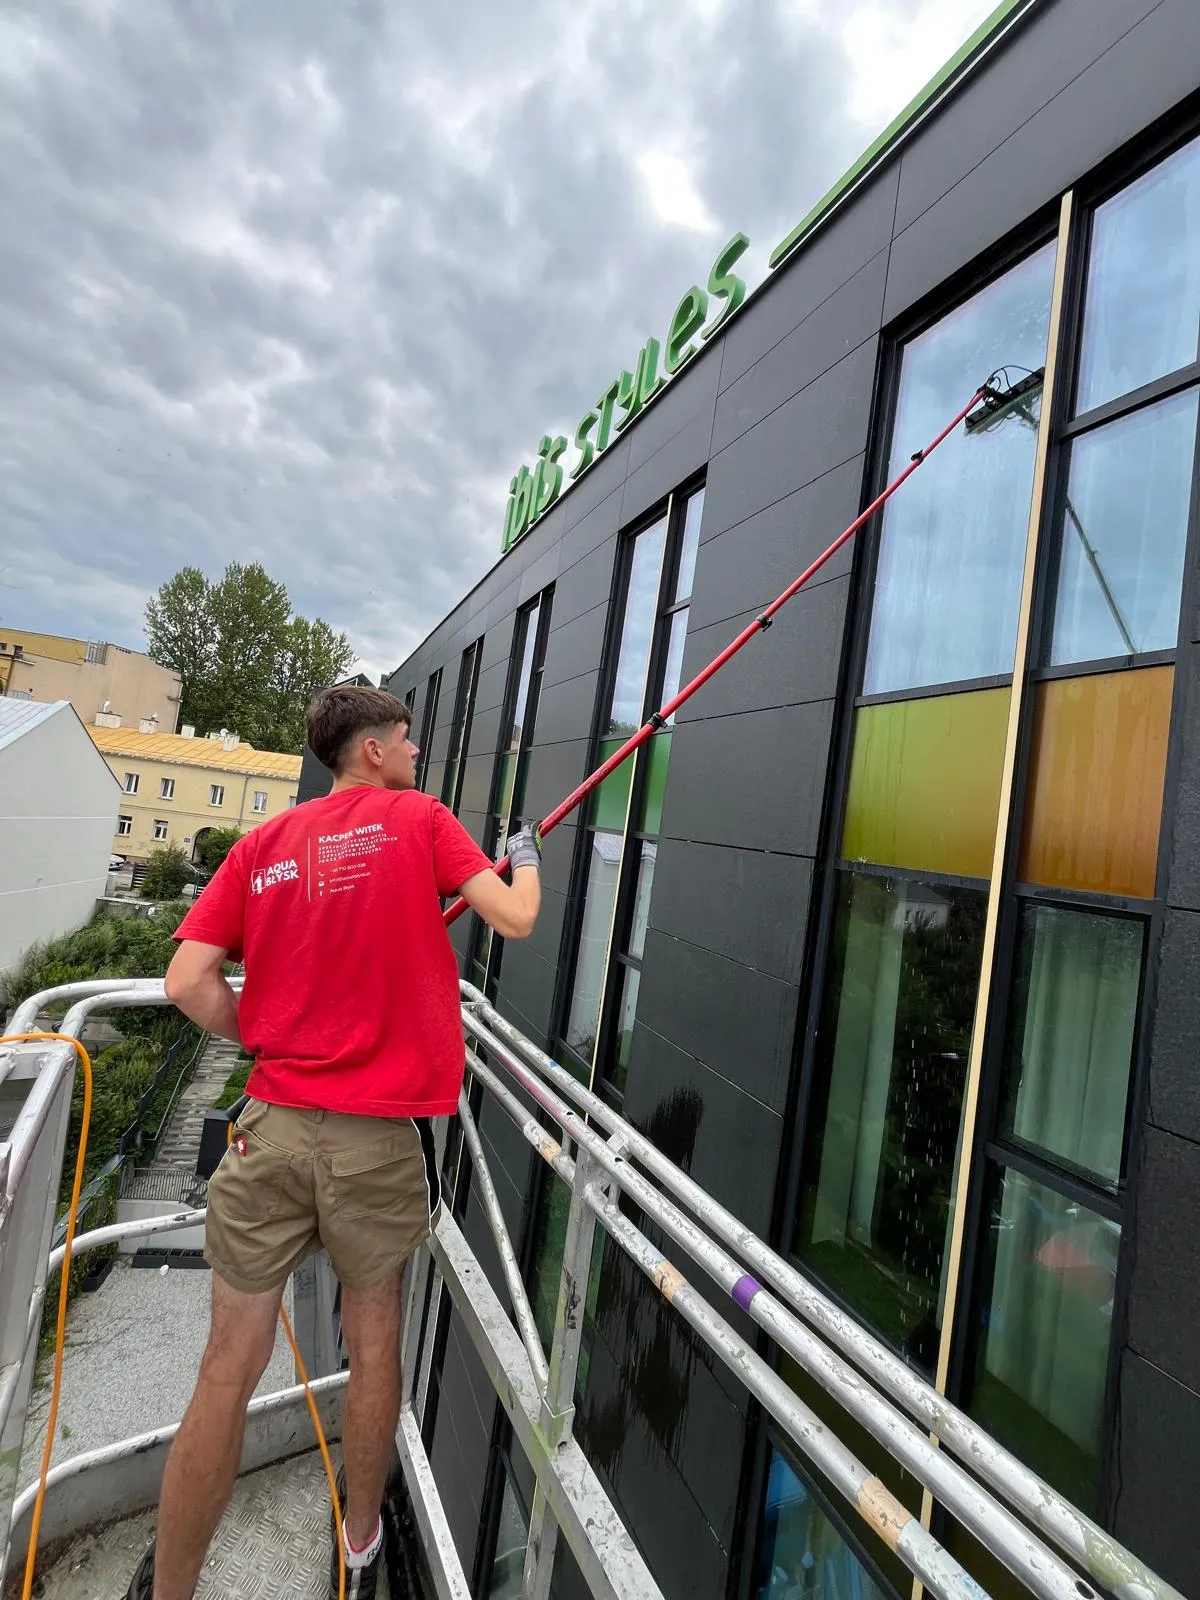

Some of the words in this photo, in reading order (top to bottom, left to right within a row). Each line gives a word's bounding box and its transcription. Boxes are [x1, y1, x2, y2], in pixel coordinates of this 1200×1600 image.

[355, 823, 384, 836] WITEK
[266, 859, 298, 877] AQUA
[266, 868, 300, 887] BŁYSK
